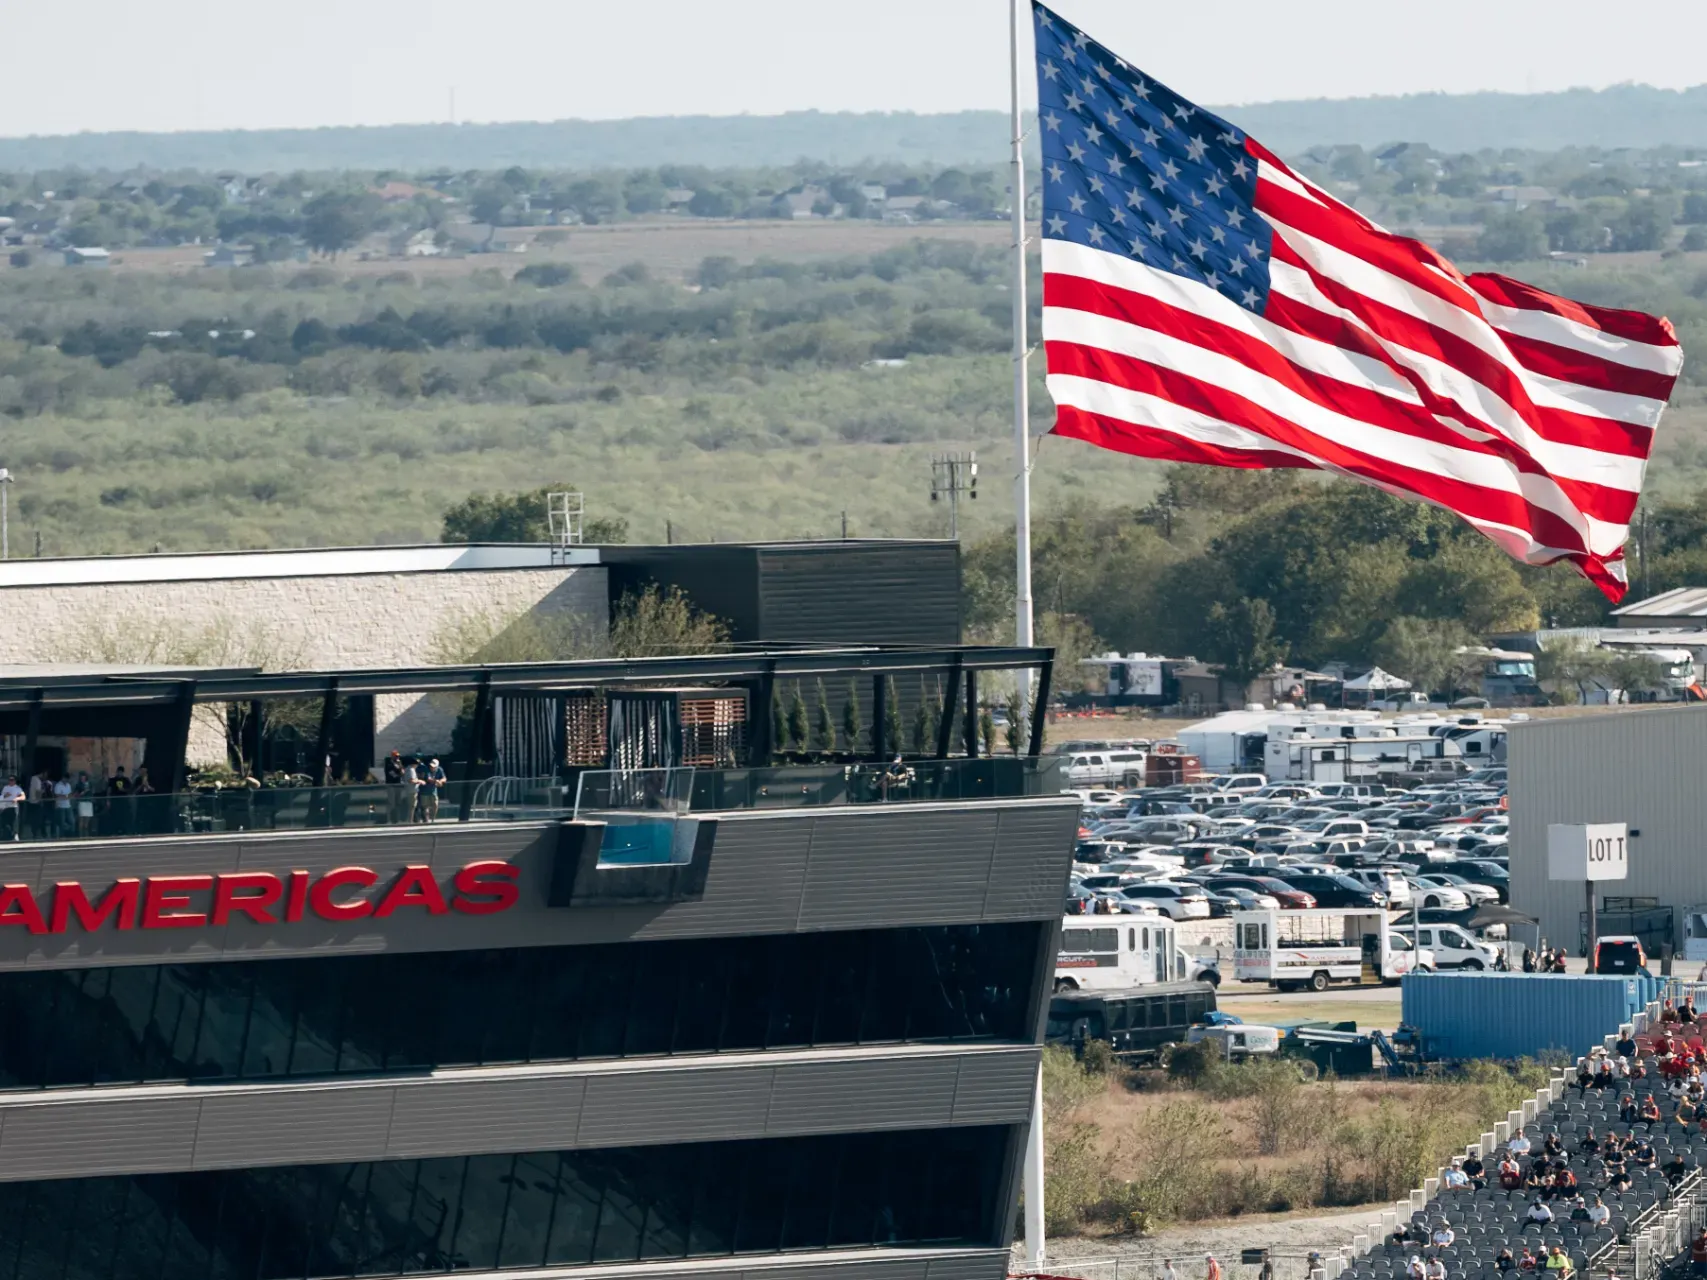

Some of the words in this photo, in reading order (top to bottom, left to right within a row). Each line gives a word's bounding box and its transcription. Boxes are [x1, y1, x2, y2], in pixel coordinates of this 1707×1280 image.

[1589, 838, 1612, 862] LOT
[1617, 837, 1624, 861] T
[0, 860, 521, 935] AMERICAS
